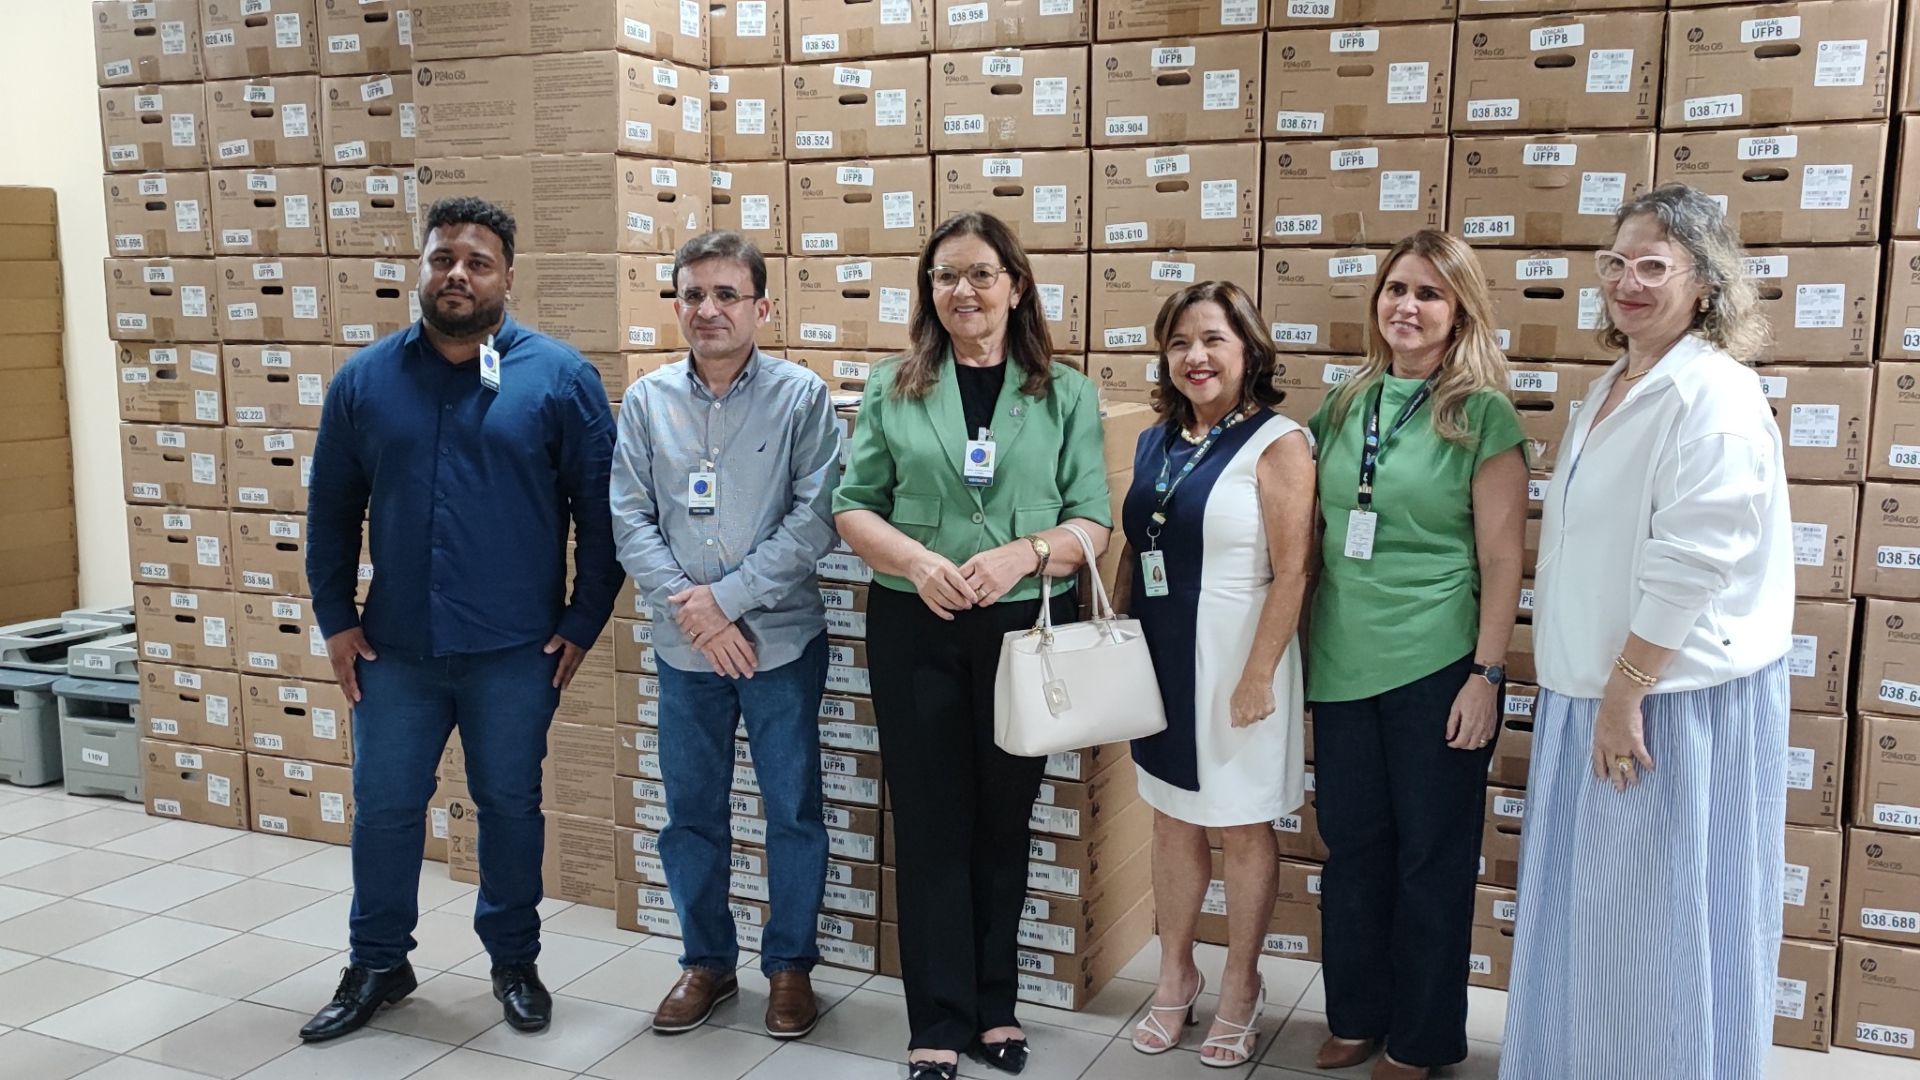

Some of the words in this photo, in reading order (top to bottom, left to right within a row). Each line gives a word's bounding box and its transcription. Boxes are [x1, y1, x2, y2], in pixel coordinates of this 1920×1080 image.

[1292, 4, 1329, 15] 032.038
[952, 10, 983, 22] 038.958
[1687, 27, 1704, 42] hp
[1752, 26, 1783, 39] UFPB
[805, 40, 835, 50] 038.963
[1340, 38, 1364, 48] UFPB
[1540, 33, 1568, 46] UFPB
[1159, 54, 1182, 64] UFPB
[990, 62, 1011, 73] UFPB
[418, 67, 432, 86] hp
[658, 75, 671, 84] UFPB
[841, 73, 860, 84] UFPB
[709, 81, 718, 90] PB
[1472, 106, 1512, 118] 038.832
[1690, 103, 1735, 117] 038.771
[944, 120, 980, 131] 038.640
[1109, 122, 1143, 134] 038.904
[1281, 118, 1318, 129] 038.671
[796, 135, 829, 146] 038.524
[1674, 146, 1690, 161] hp
[1749, 144, 1779, 156] UFPB
[1340, 156, 1364, 167] UFPB
[1533, 151, 1560, 162] UFPB
[990, 165, 1011, 175] UFPB
[1154, 162, 1177, 173] UFPB
[1675, 162, 1696, 170] P24a
[418, 166, 432, 184] hp
[655, 174, 671, 184] UFPB
[843, 173, 862, 182] UFPB
[713, 177, 721, 185] PB
[1276, 220, 1318, 232] 038.582
[1464, 220, 1510, 233] 028.481
[1109, 230, 1142, 241] 038.610
[1159, 268, 1182, 279] UFPB
[1338, 262, 1363, 274] UFPB
[1525, 265, 1552, 277] UFPB
[1746, 264, 1770, 275] FPB
[844, 270, 862, 279] UFPB
[804, 329, 831, 339] 038.966
[1109, 333, 1141, 345] 038.722
[1275, 329, 1311, 341] 028.437
[840, 366, 858, 376] UFPB
[1515, 378, 1542, 389] UFPB
[1897, 375, 1915, 390] hp
[1529, 488, 1539, 496] PB
[1881, 498, 1899, 513] hp
[823, 596, 841, 605] FPB
[1886, 615, 1903, 629] hp
[829, 653, 842, 661] FPB
[823, 706, 844, 716] UFPB
[642, 739, 656, 748] UFP
[1880, 735, 1896, 750] hp
[737, 750, 746, 759] PB
[824, 761, 845, 771] UFPB
[640, 788, 658, 798] UFPB
[730, 801, 747, 811] FPB
[1504, 804, 1523, 814] UFP
[823, 814, 838, 823] FPB
[1271, 818, 1297, 829] .564
[1880, 812, 1920, 824] 032.01
[1032, 847, 1043, 856] PB
[1866, 844, 1882, 858] hp
[731, 859, 750, 869] UFPB
[826, 870, 840, 879] FPB
[645, 895, 664, 906] UFPB
[732, 910, 751, 920] UFPB
[1025, 905, 1036, 914] PB
[1863, 914, 1916, 929] 038.688
[821, 922, 842, 934] UFPB
[1268, 941, 1302, 950] 038.719
[1019, 958, 1041, 969] UFPB
[1857, 1028, 1908, 1044] 026.035
